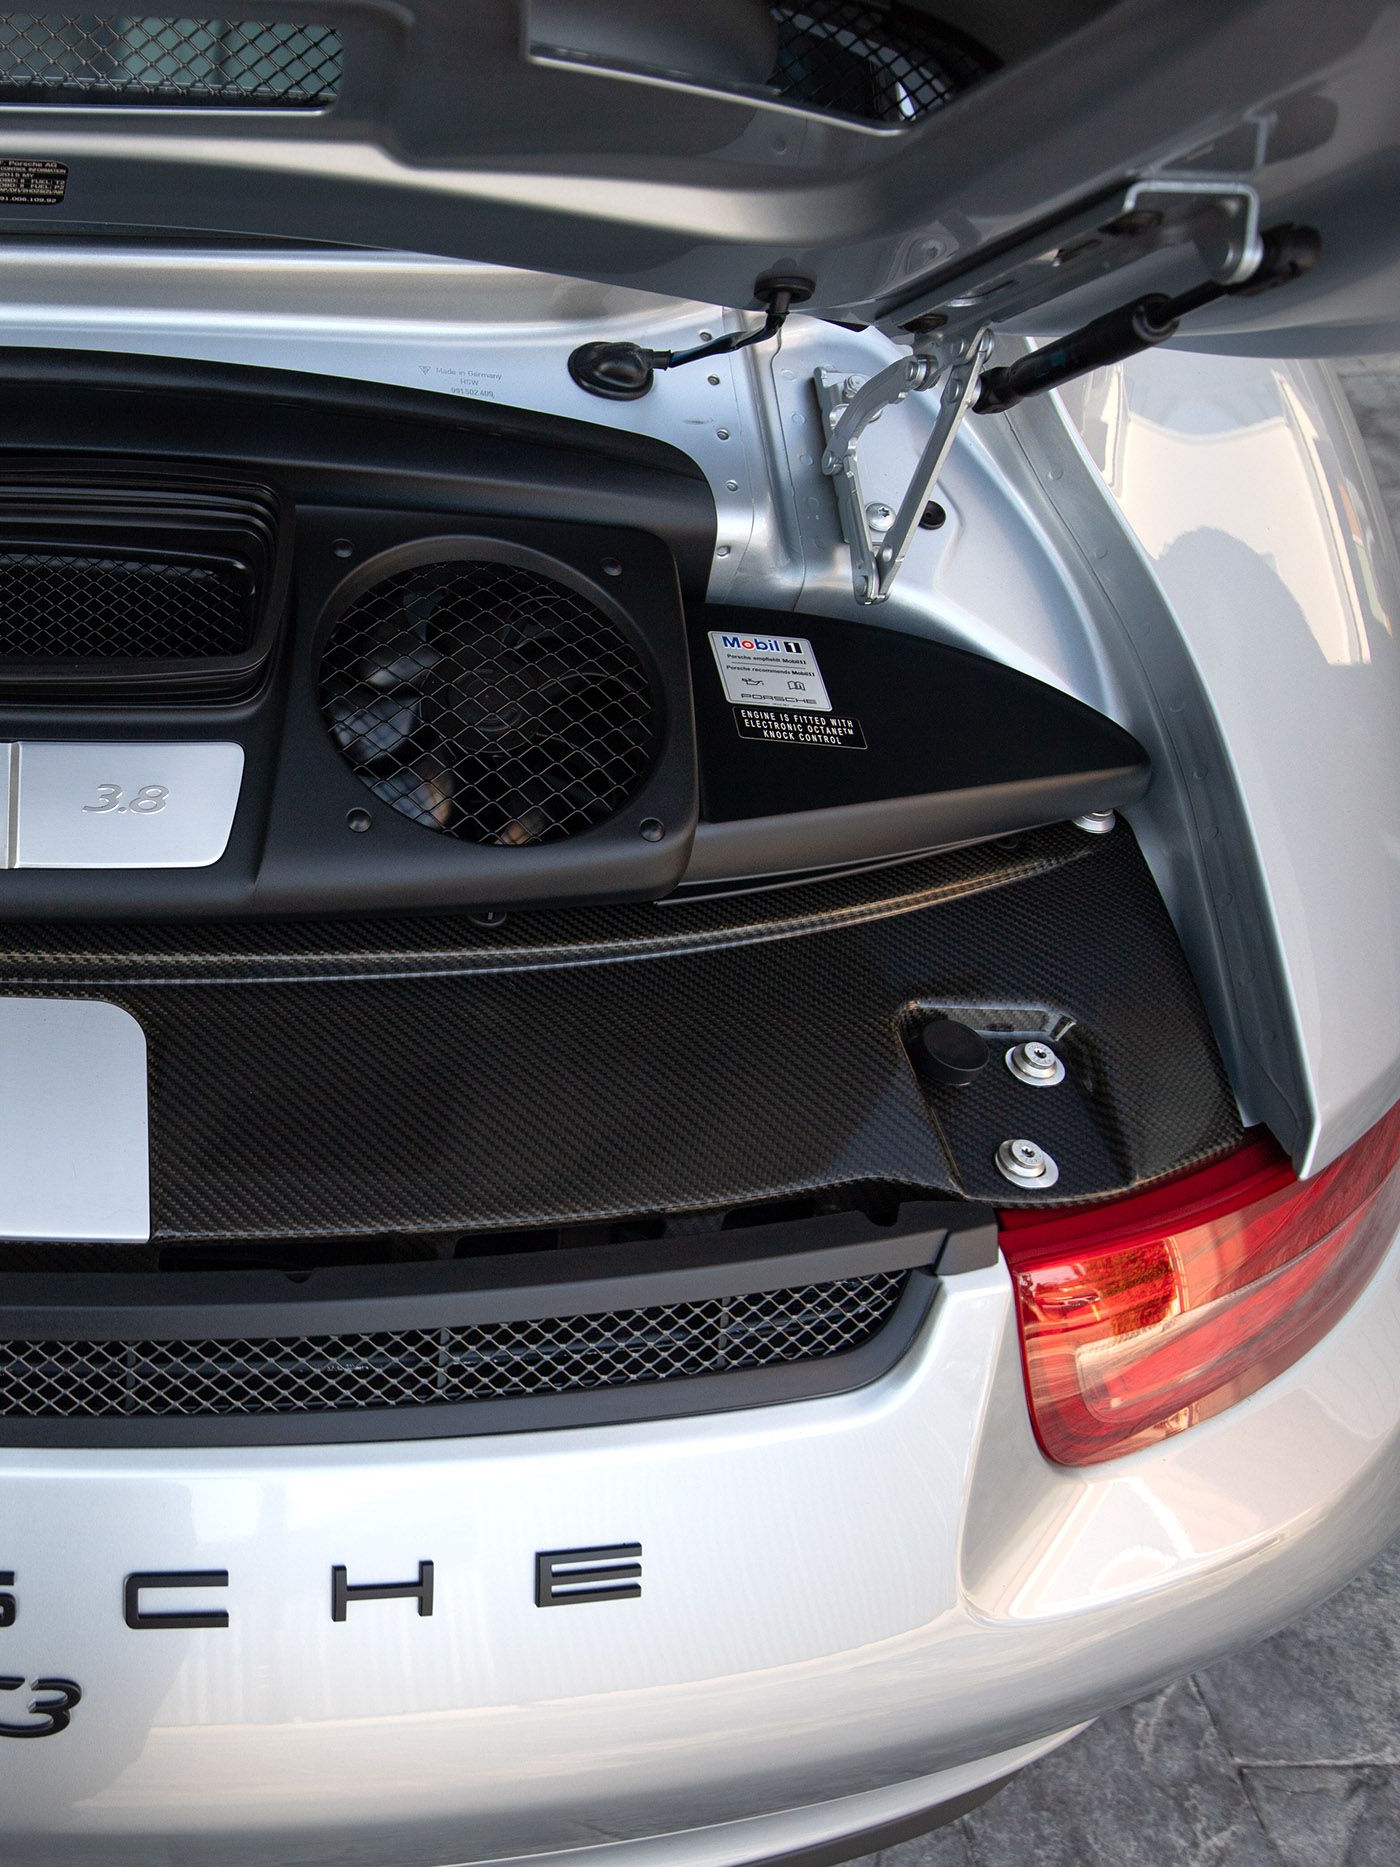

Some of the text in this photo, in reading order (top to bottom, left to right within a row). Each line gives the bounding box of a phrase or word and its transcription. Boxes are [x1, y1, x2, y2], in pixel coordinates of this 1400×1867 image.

[436, 367, 457, 376] Made
[467, 371, 503, 381] Germany
[722, 636, 801, 653] Mobil 1
[753, 656, 781, 664] empfiehlt
[752, 667, 791, 675] recommends
[741, 693, 817, 705] PORSCHE
[740, 709, 854, 728] ENGINE IS FITTED WITH
[744, 718, 803, 732] ELECTRONIC
[763, 730, 842, 745] KNOCK CONTROL
[81, 782, 169, 815] 3.8
